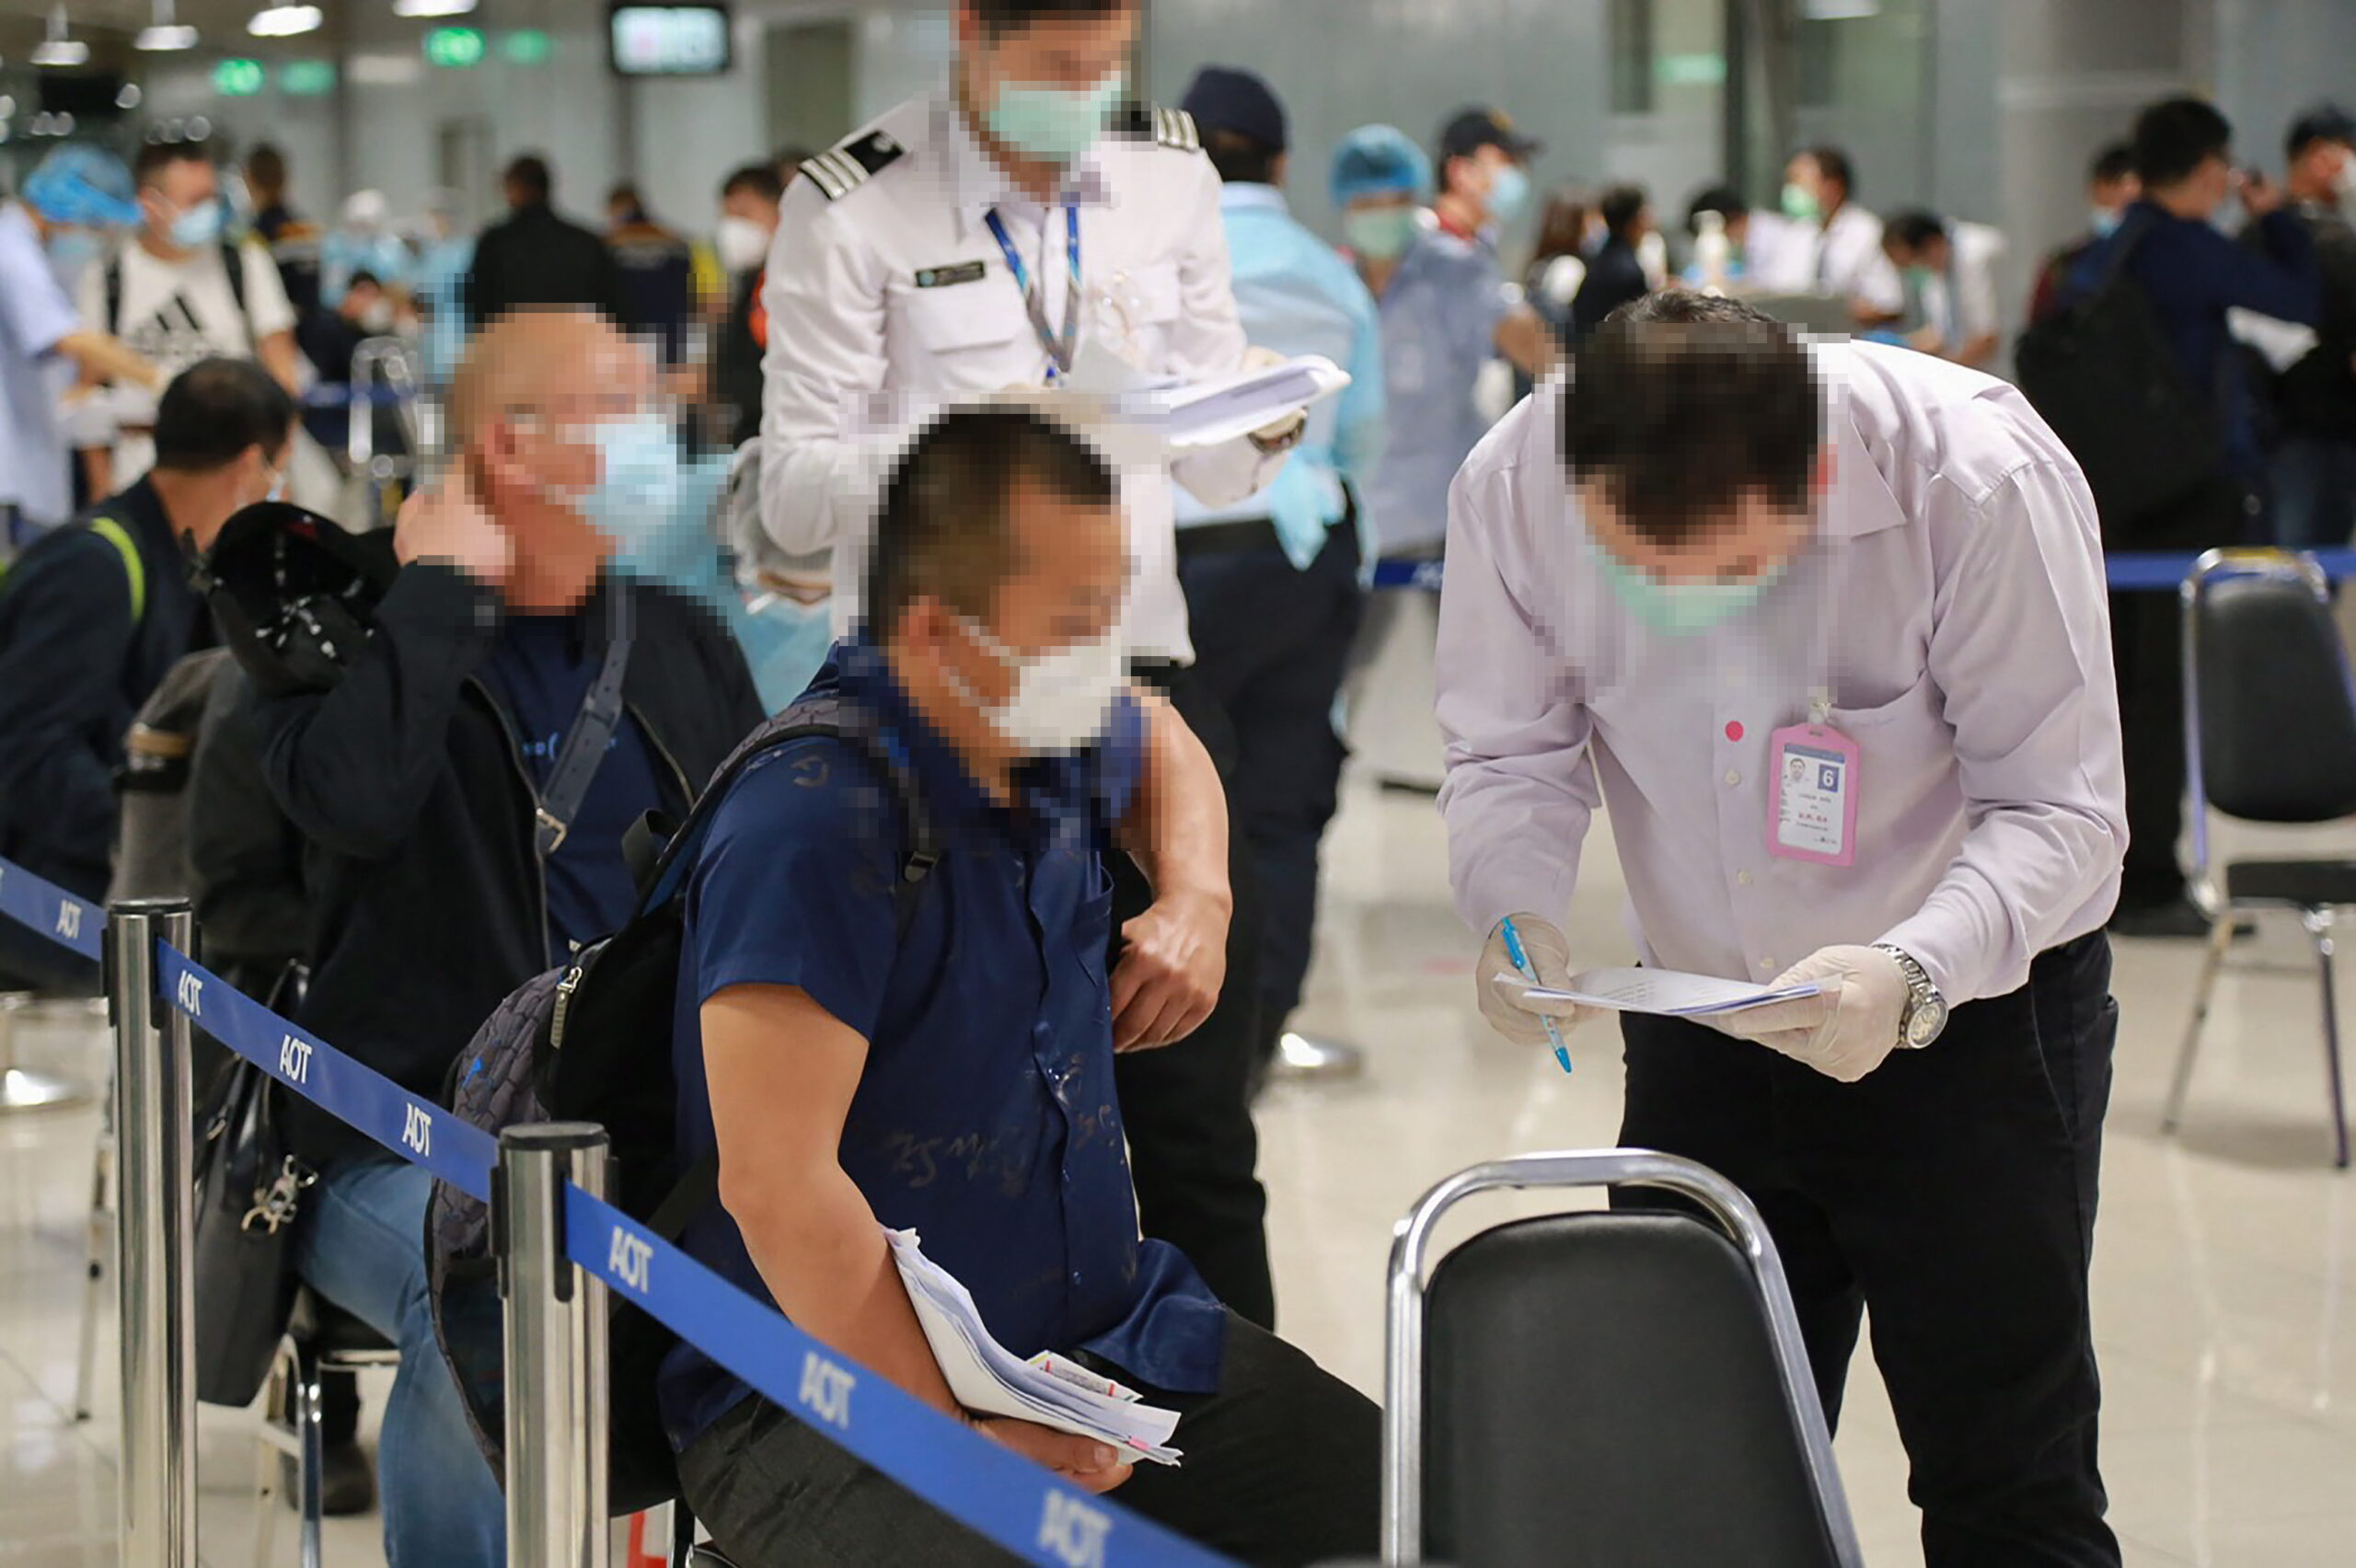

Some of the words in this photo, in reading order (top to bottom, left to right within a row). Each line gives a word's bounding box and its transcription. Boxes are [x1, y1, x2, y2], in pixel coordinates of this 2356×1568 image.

[1822, 769, 1834, 787] 6
[56, 900, 82, 939] AOT
[178, 970, 203, 1016] AOT
[279, 1033, 313, 1084] AOT
[401, 1102, 433, 1157] AOT
[608, 1226, 653, 1293] AOT
[799, 1352, 856, 1428] AOT
[1041, 1489, 1112, 1568] AOT
